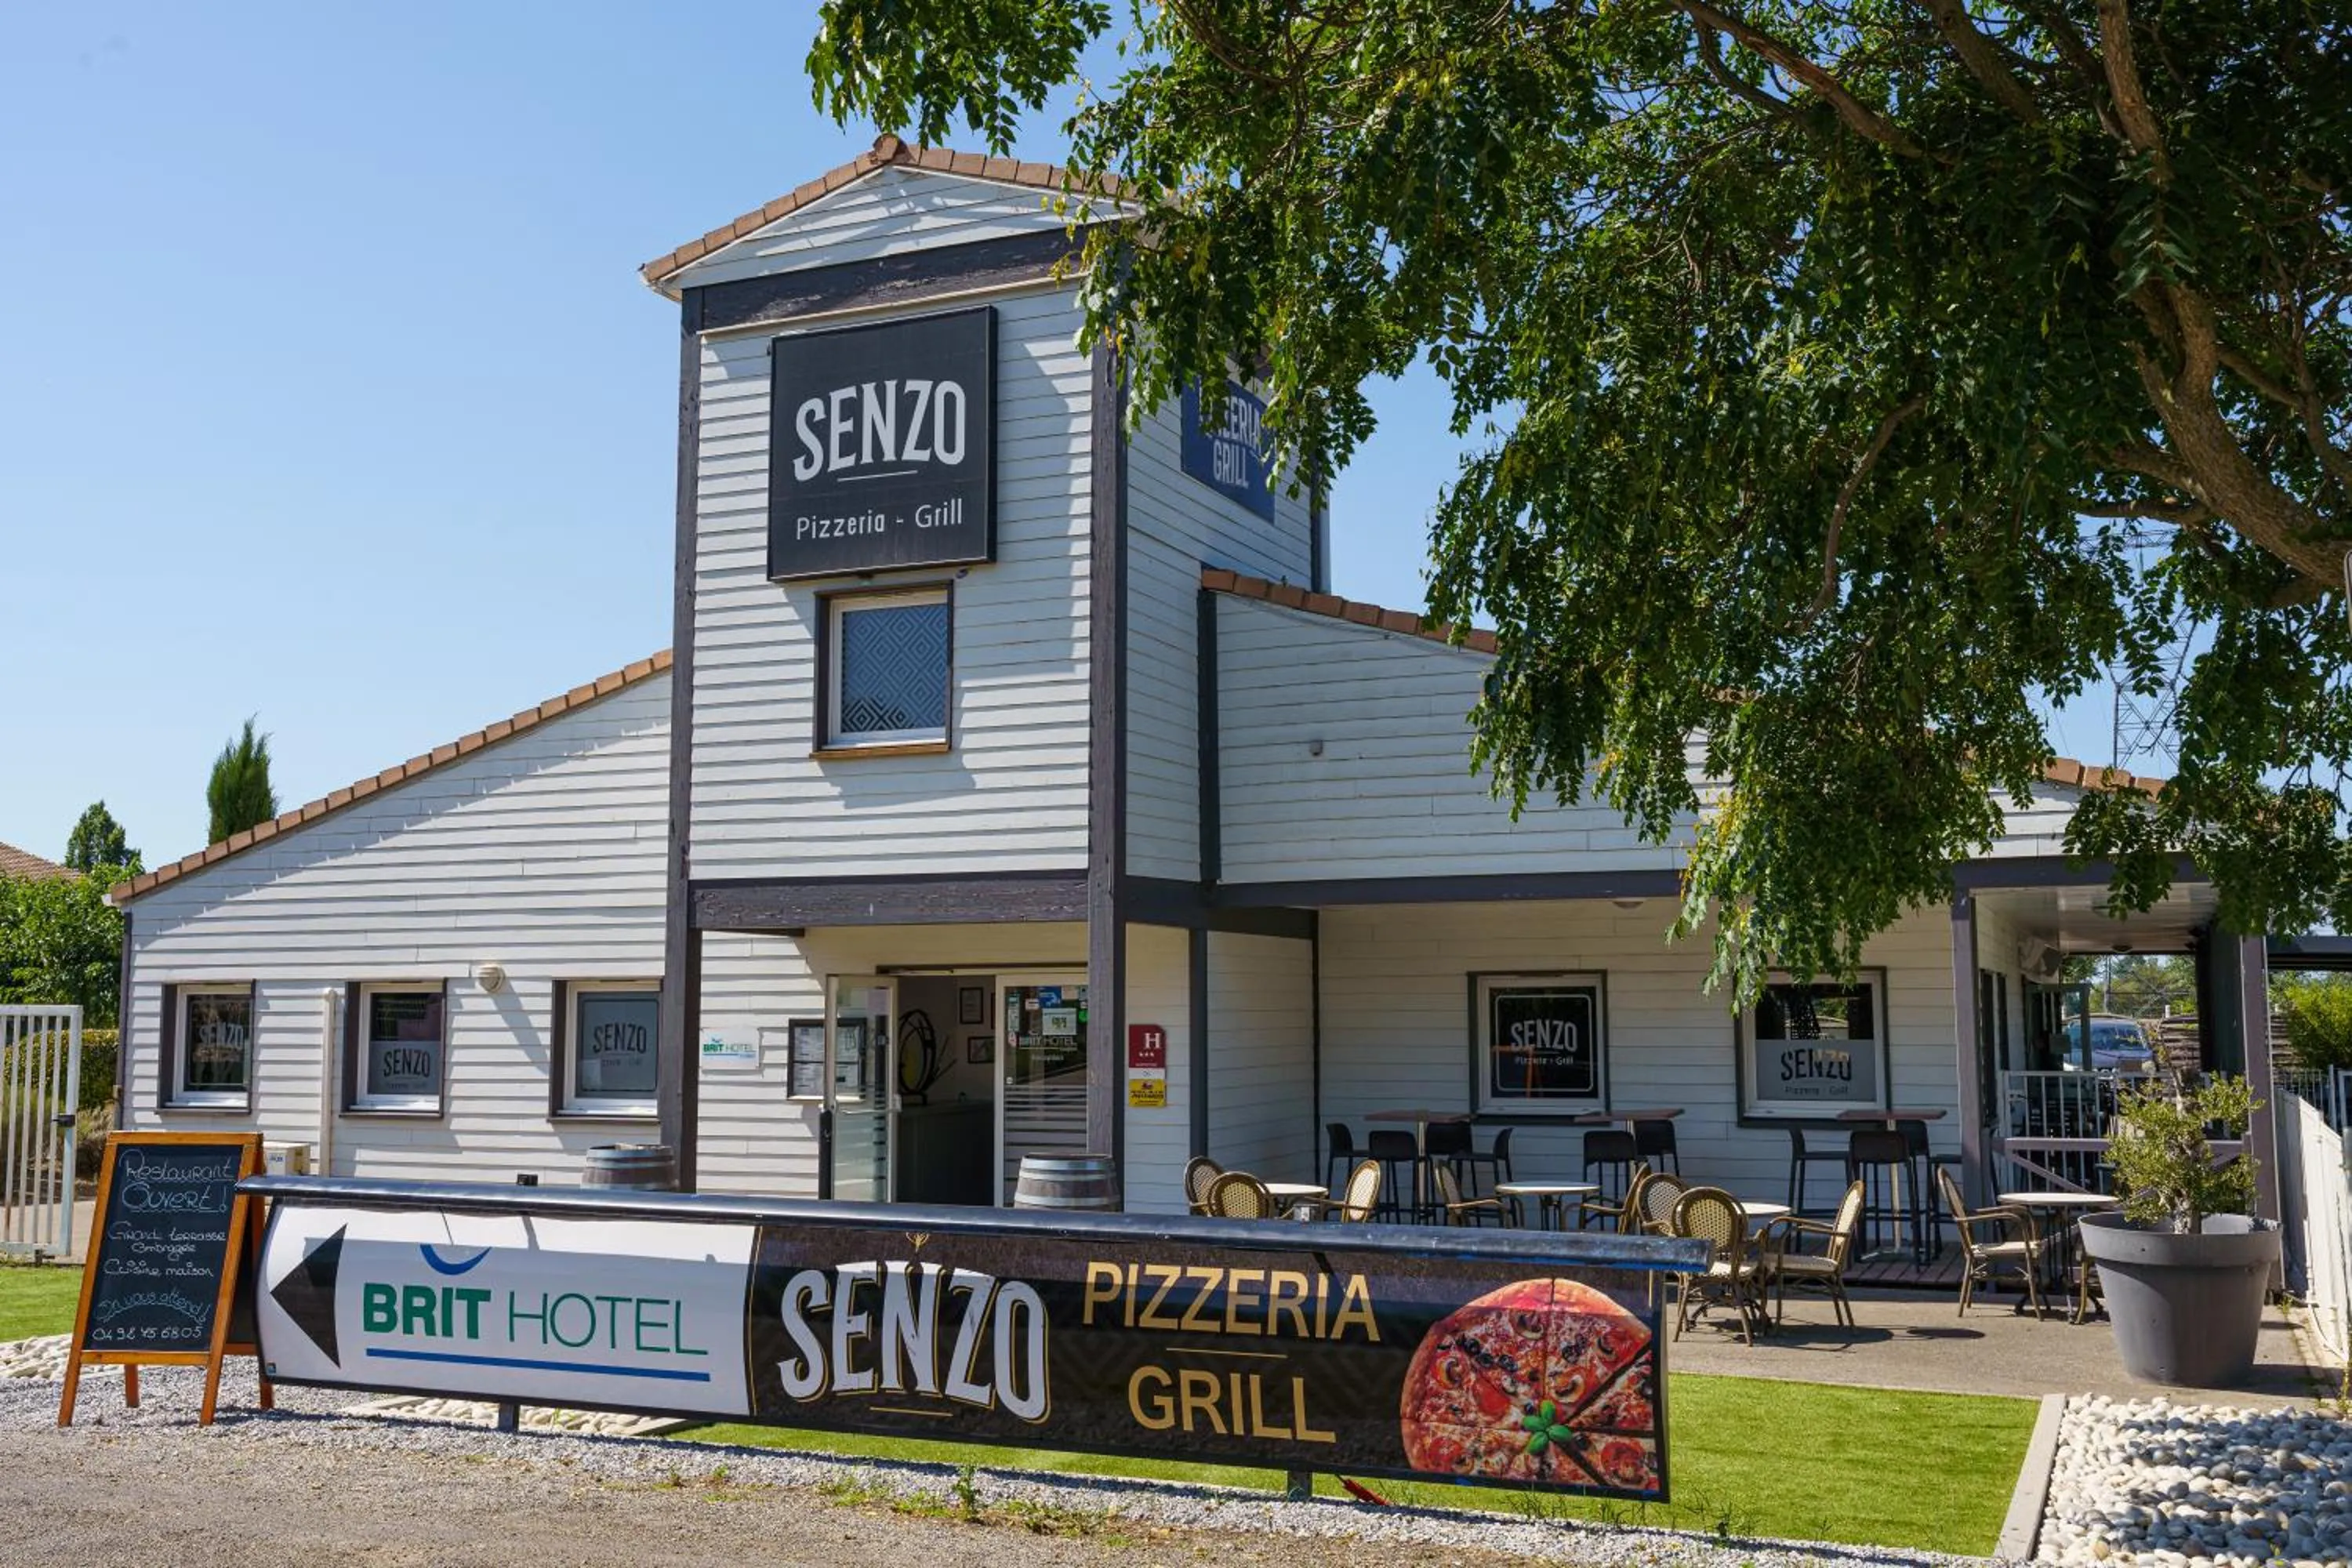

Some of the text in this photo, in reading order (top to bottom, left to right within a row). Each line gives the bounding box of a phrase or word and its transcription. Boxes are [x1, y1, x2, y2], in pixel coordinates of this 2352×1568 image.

[793, 379, 966, 482] SENZO
[1213, 439, 1249, 490] GRILL
[797, 509, 885, 540] Pizzeria
[915, 498, 962, 528] Grill
[199, 1022, 244, 1050] SENZO
[592, 1022, 647, 1054] SENZO
[703, 1044, 724, 1052] BRIT
[1044, 1036, 1077, 1047] HOTEL
[1145, 1033, 1160, 1049] H
[1511, 1018, 1577, 1052] SENZO
[383, 1047, 430, 1078] SENZO
[1780, 1048, 1852, 1081] SENZO
[165, 1261, 214, 1276] maison
[1082, 1261, 1381, 1342] PIZZERIA
[363, 1283, 710, 1356] BRIT HOTEL
[776, 1259, 1051, 1424] SENZO
[1128, 1366, 1337, 1443] GRILL
